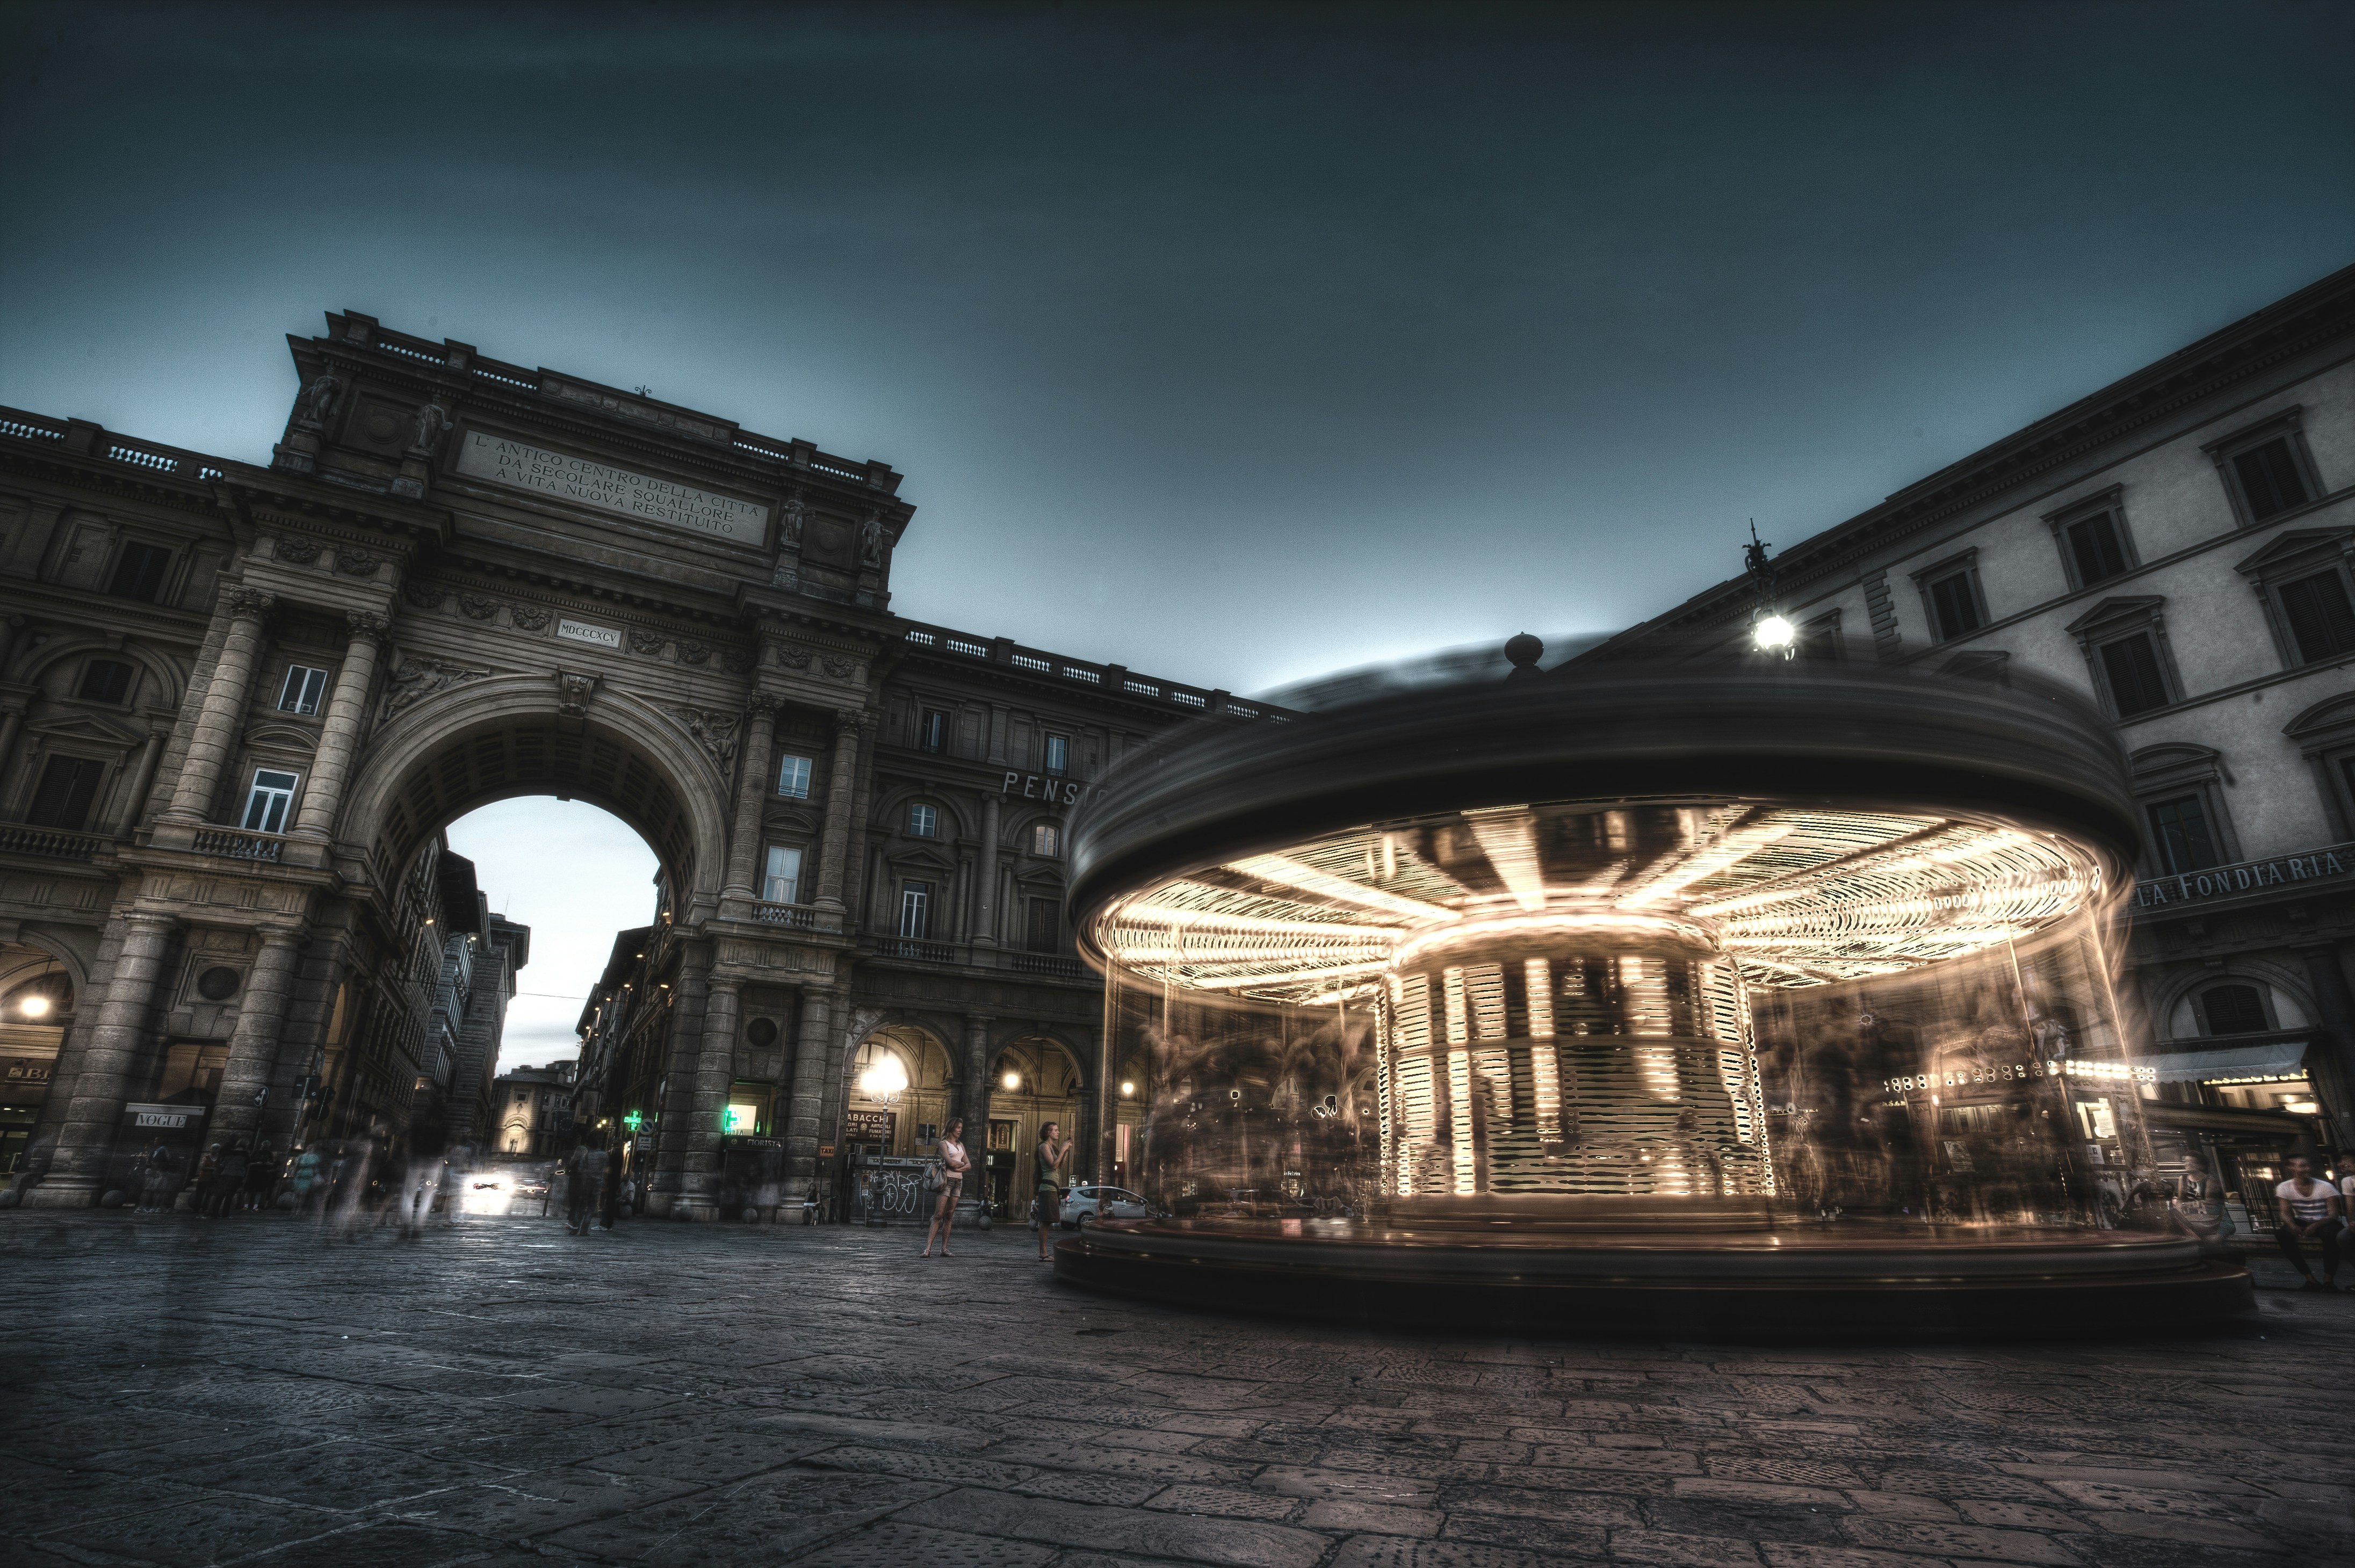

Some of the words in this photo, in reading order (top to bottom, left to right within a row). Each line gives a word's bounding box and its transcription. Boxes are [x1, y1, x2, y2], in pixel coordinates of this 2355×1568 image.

[475, 436, 489, 447] L'
[495, 442, 562, 466] ANTICO
[569, 460, 640, 486] CENTRO
[647, 480, 703, 503] DELLA
[499, 454, 522, 469] DA
[531, 463, 626, 495] SECOLARE
[633, 489, 734, 522] SQUALLORE
[495, 468, 507, 478] A
[517, 472, 556, 490] VITA
[565, 484, 624, 508] NUOVA
[633, 501, 733, 533] RESTITUITO
[561, 624, 617, 642] MDCCCXCV
[2137, 884, 2168, 908] LA
[2178, 852, 2345, 900] FONDIARIA
[140, 1114, 186, 1127] VOGUE
[747, 1139, 781, 1147] FIORISTA
